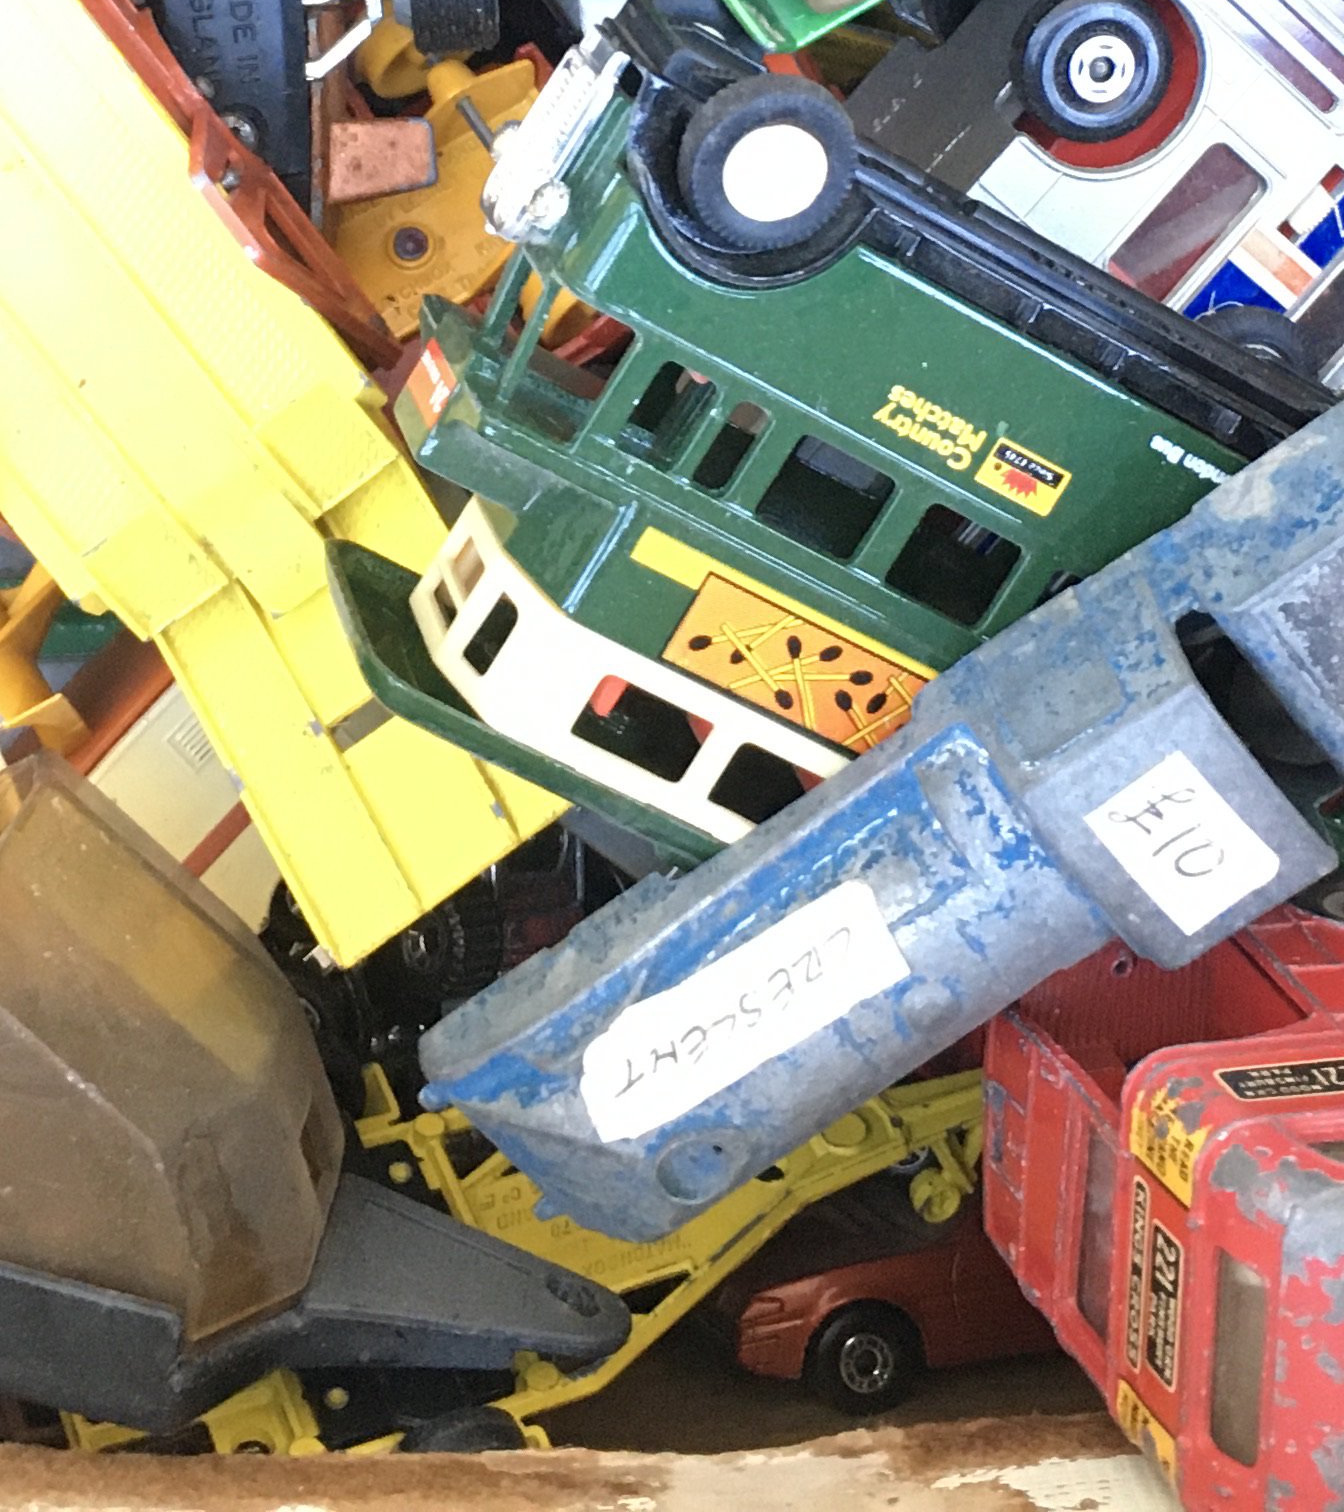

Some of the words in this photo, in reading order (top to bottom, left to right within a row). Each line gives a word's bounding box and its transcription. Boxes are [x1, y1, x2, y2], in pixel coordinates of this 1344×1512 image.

[237, 54, 261, 85] IN
[871, 402, 972, 470] Country
[887, 383, 987, 452] Matches
[1183, 453, 1227, 484] ndon
[1108, 778, 1223, 871] £10
[615, 928, 849, 1098] CRESCENT
[1153, 1233, 1176, 1293] 221
